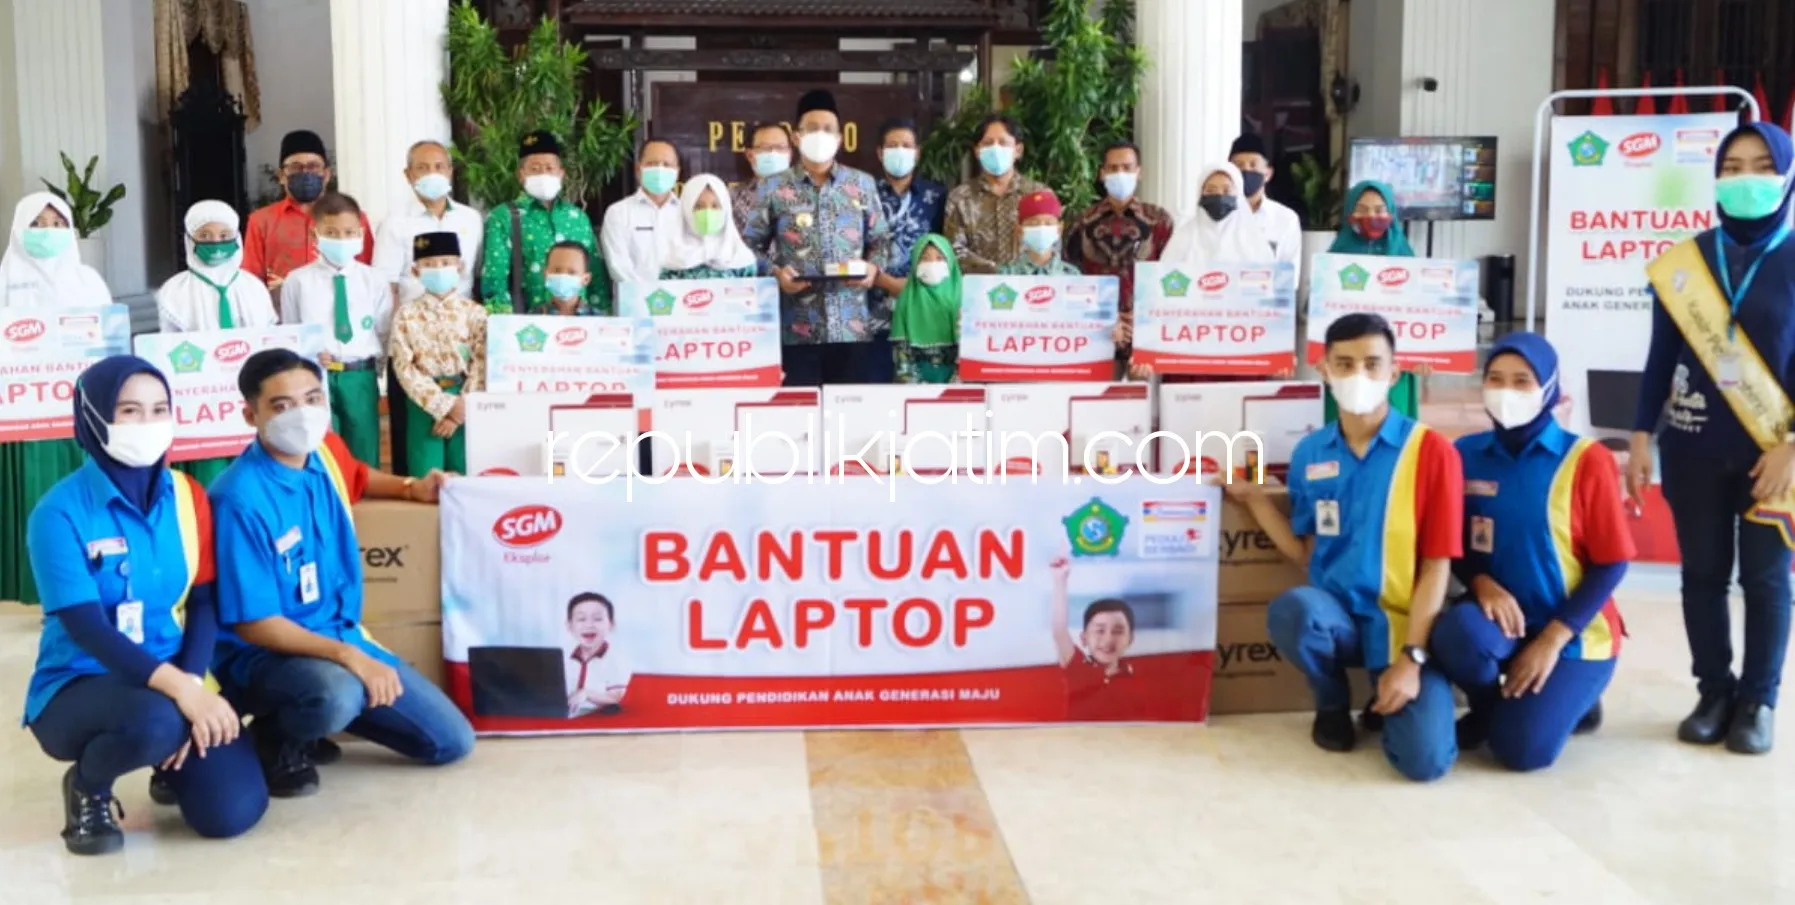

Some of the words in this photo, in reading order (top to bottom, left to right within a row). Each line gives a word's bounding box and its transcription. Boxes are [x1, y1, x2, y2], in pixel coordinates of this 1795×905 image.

[1623, 134, 1658, 155] SGM
[1570, 210, 1711, 230] BANTUAN
[1379, 269, 1408, 283] SGM
[1603, 301, 1651, 310] GENER
[10, 319, 41, 339] SGM
[1160, 324, 1266, 343] LAPTOP
[1393, 321, 1447, 340] TOP
[654, 340, 753, 361] APTOP
[986, 335, 1089, 353] LAPTOP
[174, 384, 237, 396] NYERAHA
[501, 510, 557, 540] SGM
[643, 529, 1025, 582] BANTUAN
[688, 597, 995, 650] LAPTOP
[1216, 641, 1282, 669] yrex
[667, 693, 732, 705] DUKUNG
[736, 691, 829, 704] PENDIDIKAN
[833, 690, 874, 702] ANAK
[879, 689, 955, 701] GENERASI
[958, 688, 1000, 700] MAJU
